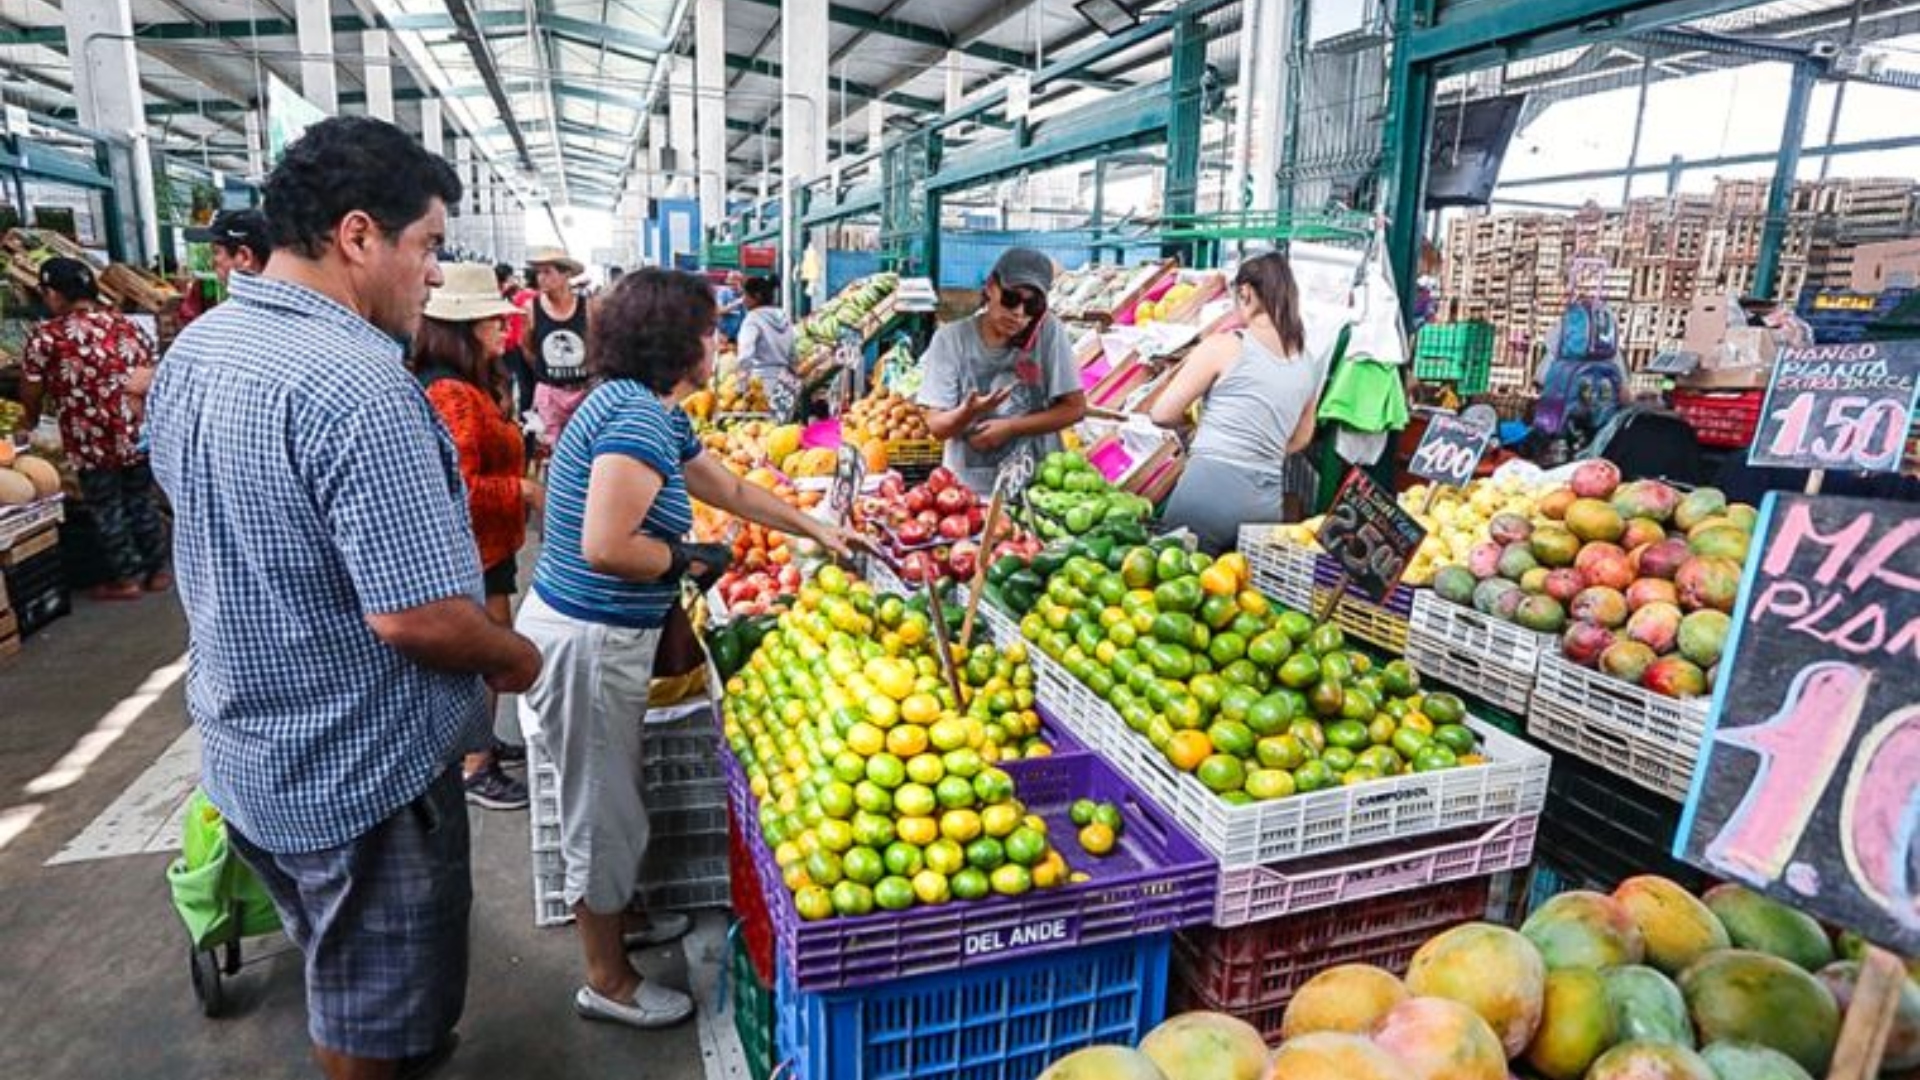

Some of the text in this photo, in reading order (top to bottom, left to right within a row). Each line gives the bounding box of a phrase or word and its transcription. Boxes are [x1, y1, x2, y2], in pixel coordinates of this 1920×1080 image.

[1785, 343, 1875, 360] MANGO
[1780, 359, 1888, 378] PLANTA
[965, 918, 1067, 955] DEL ANDE
